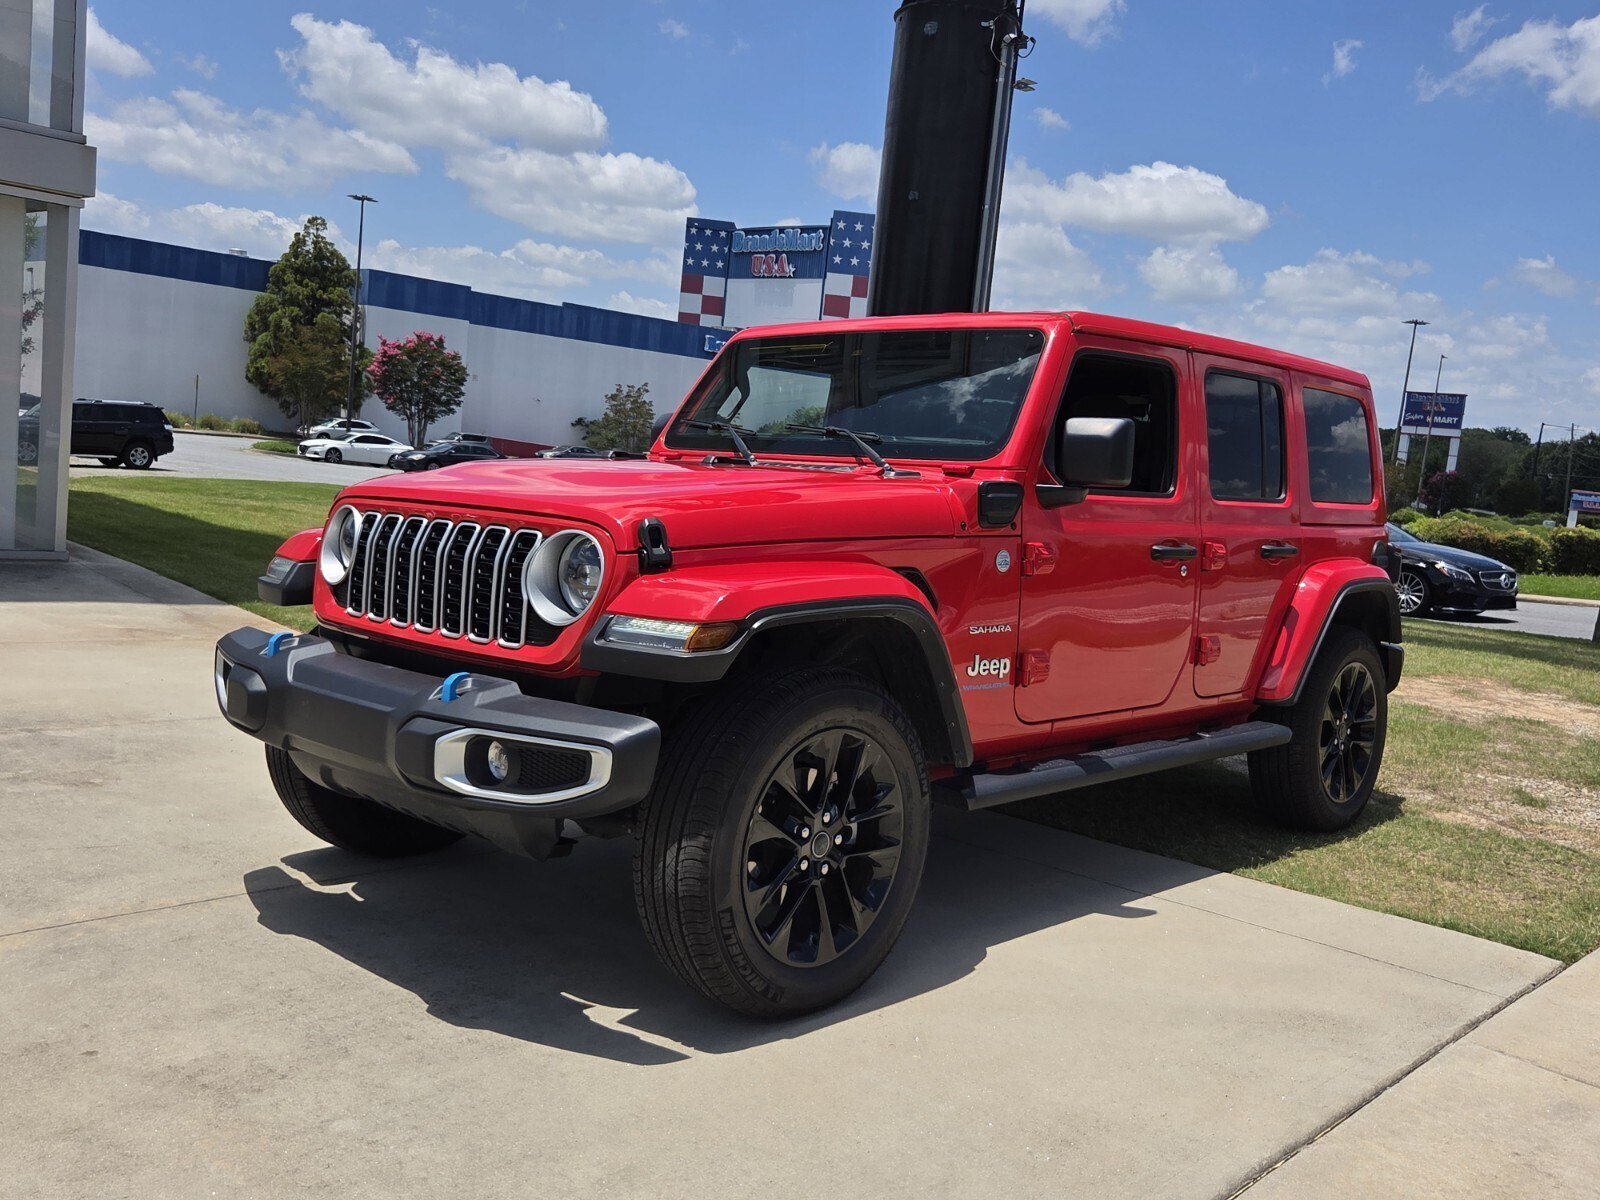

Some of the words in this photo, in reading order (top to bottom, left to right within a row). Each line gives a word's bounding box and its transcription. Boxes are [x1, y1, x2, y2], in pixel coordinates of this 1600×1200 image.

[732, 229, 823, 252] BrandsMart
[1434, 416, 1458, 424] MART
[969, 625, 1012, 635] SAHARA
[967, 654, 1011, 679] Jeep
[718, 909, 768, 994] MICHELIN
